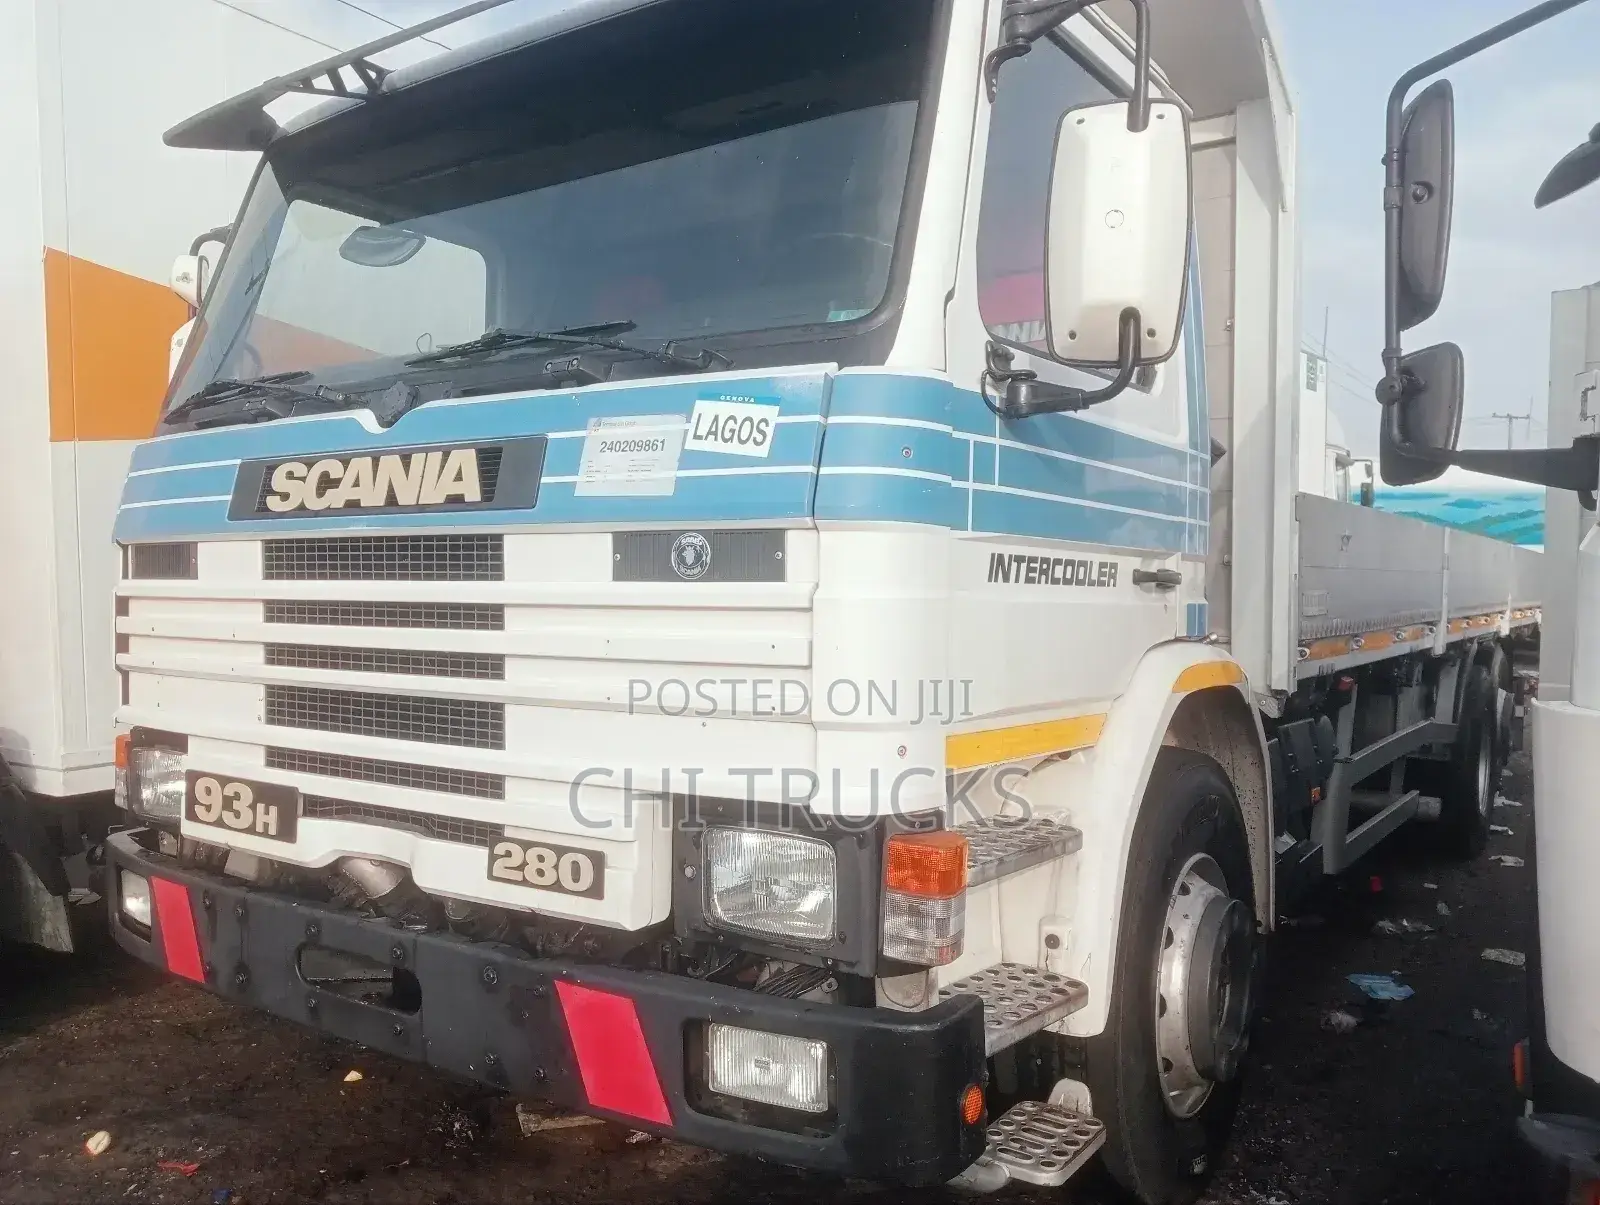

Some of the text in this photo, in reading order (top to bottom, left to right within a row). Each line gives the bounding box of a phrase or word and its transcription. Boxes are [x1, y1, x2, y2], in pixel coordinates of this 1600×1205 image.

[719, 394, 755, 403] GENOVA
[599, 438, 666, 453] 240209861
[692, 412, 770, 447] LAGOS
[265, 448, 482, 512] SCANIA
[987, 552, 1119, 588] INTERCOOLER
[492, 841, 594, 893] 280
